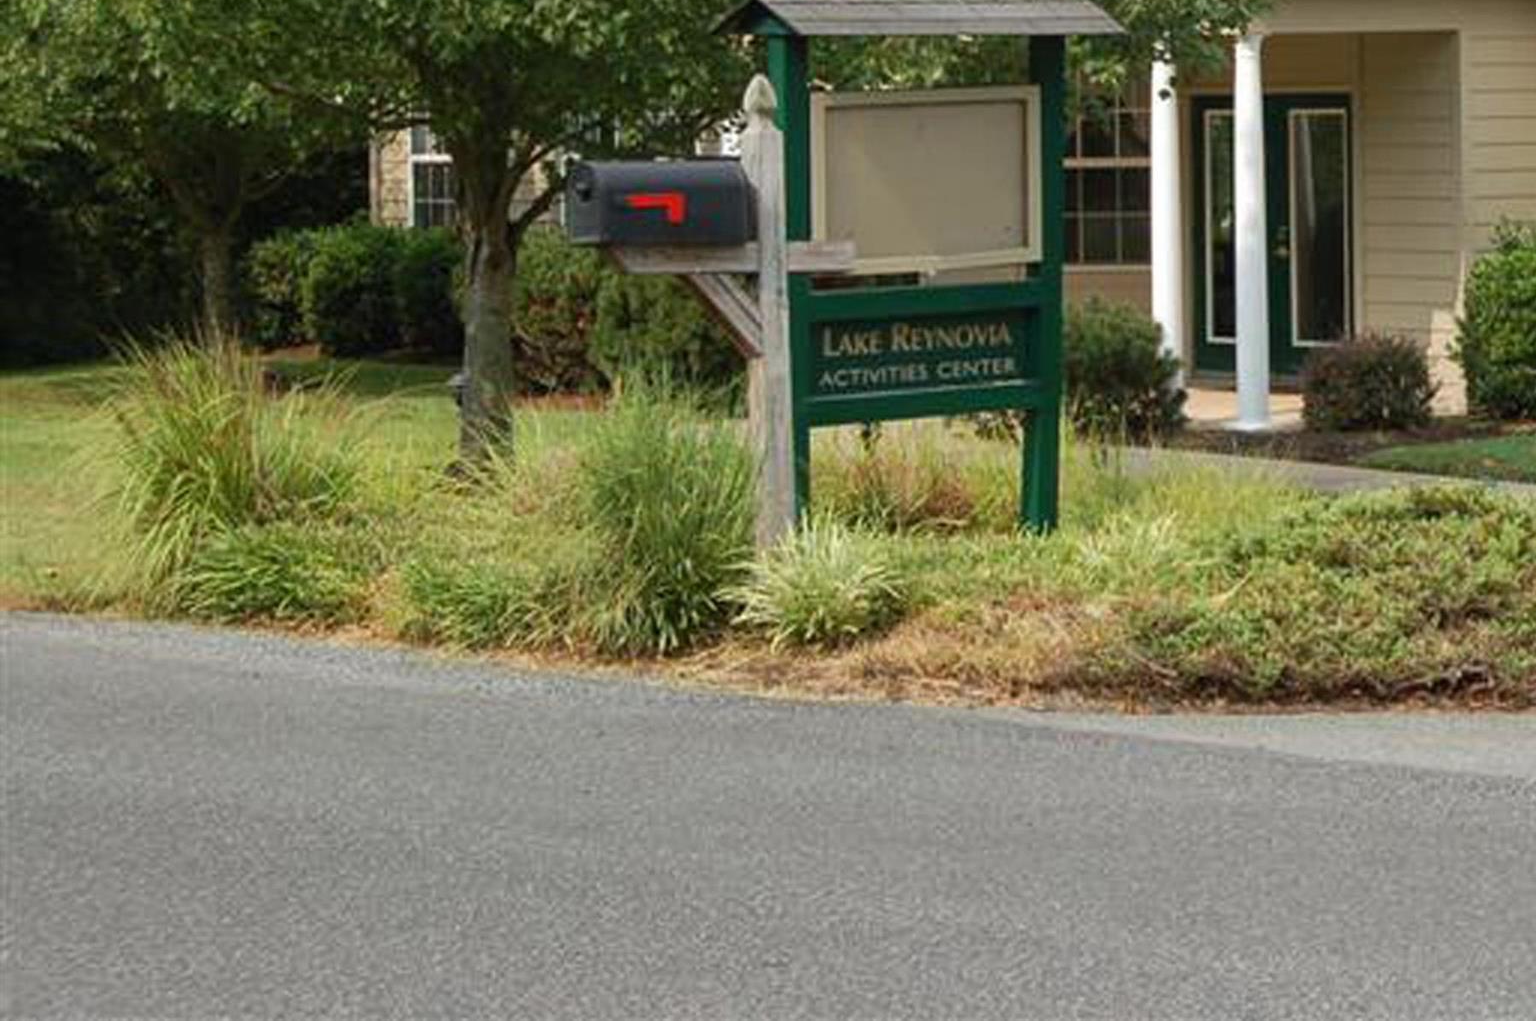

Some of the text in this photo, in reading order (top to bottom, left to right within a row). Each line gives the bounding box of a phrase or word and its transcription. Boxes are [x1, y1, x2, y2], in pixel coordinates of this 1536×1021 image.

[823, 323, 1013, 357] LAKE REYNOVIA
[819, 357, 1015, 388] ACTIVITIES CENTER
